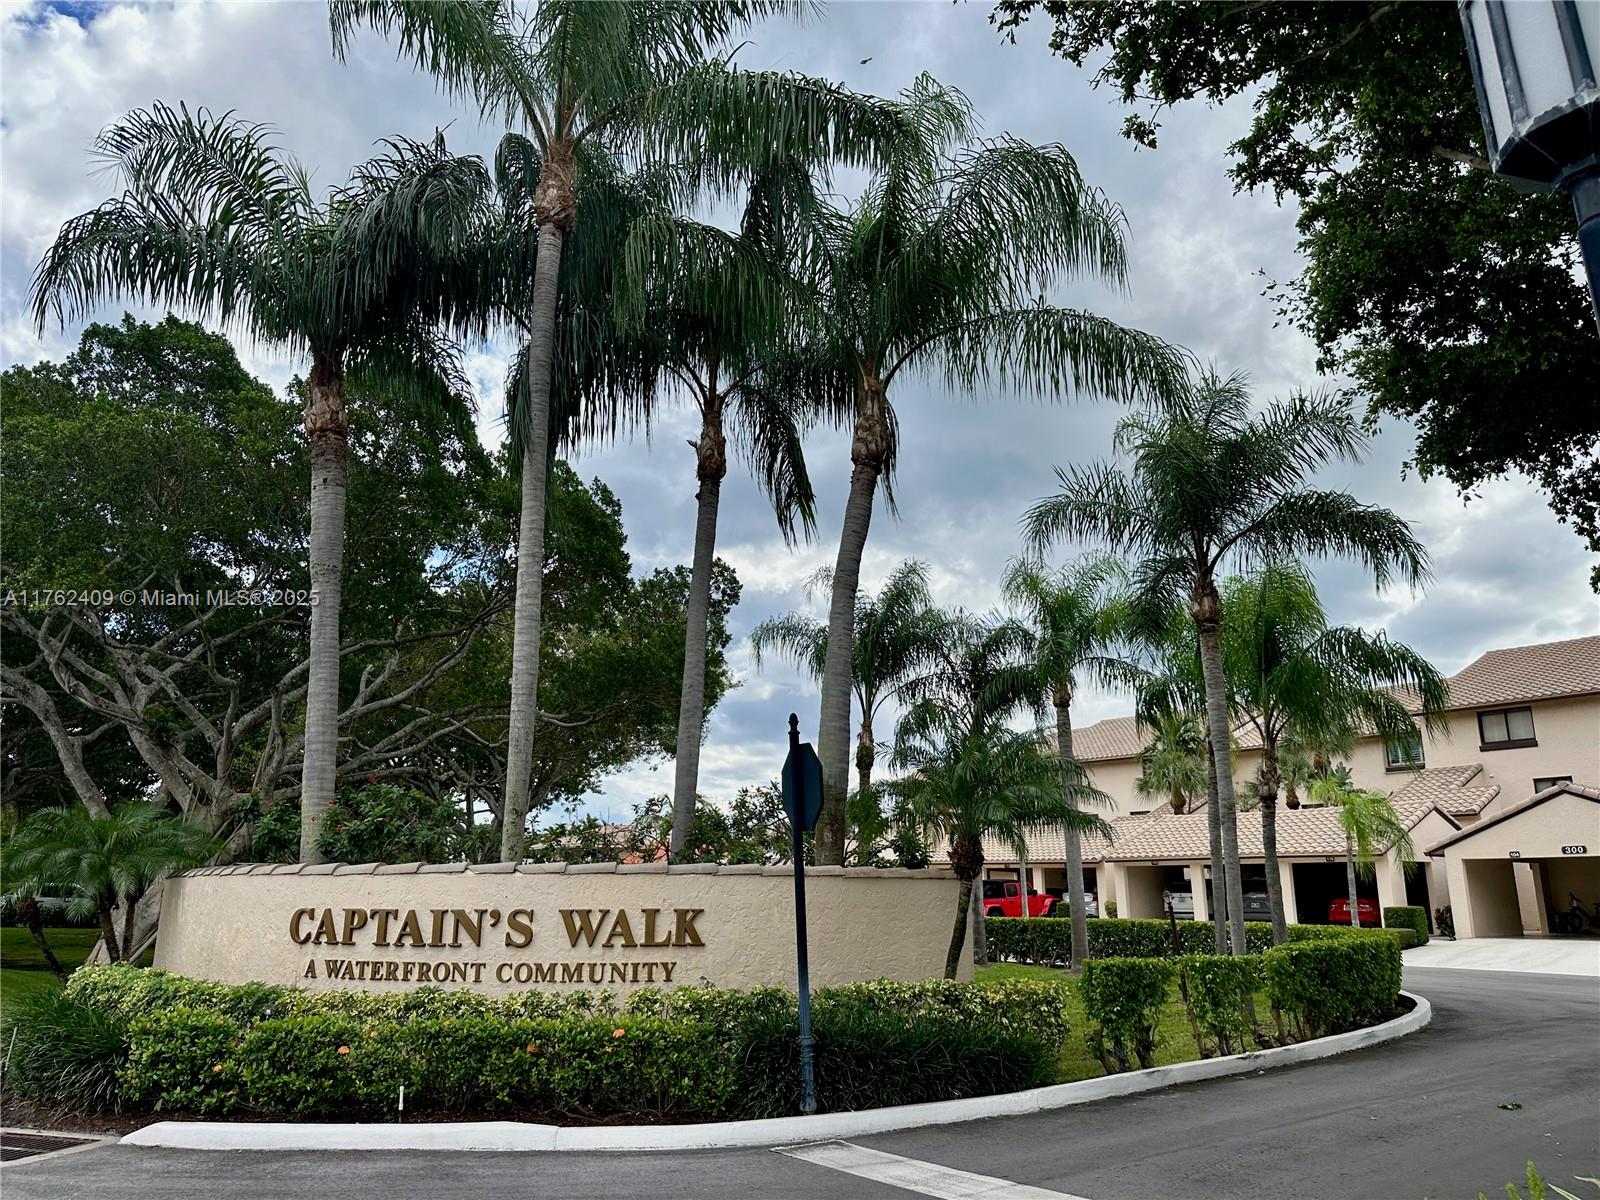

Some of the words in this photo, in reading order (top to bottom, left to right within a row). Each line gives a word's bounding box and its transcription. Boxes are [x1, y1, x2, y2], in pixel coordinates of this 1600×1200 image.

[1564, 846, 1584, 854] 300
[289, 908, 534, 948] CAPTAIN'S
[558, 908, 706, 948] WALK
[303, 959, 318, 979] A
[324, 959, 487, 983] WATERFRONT
[495, 961, 678, 984] COMMUNITY
